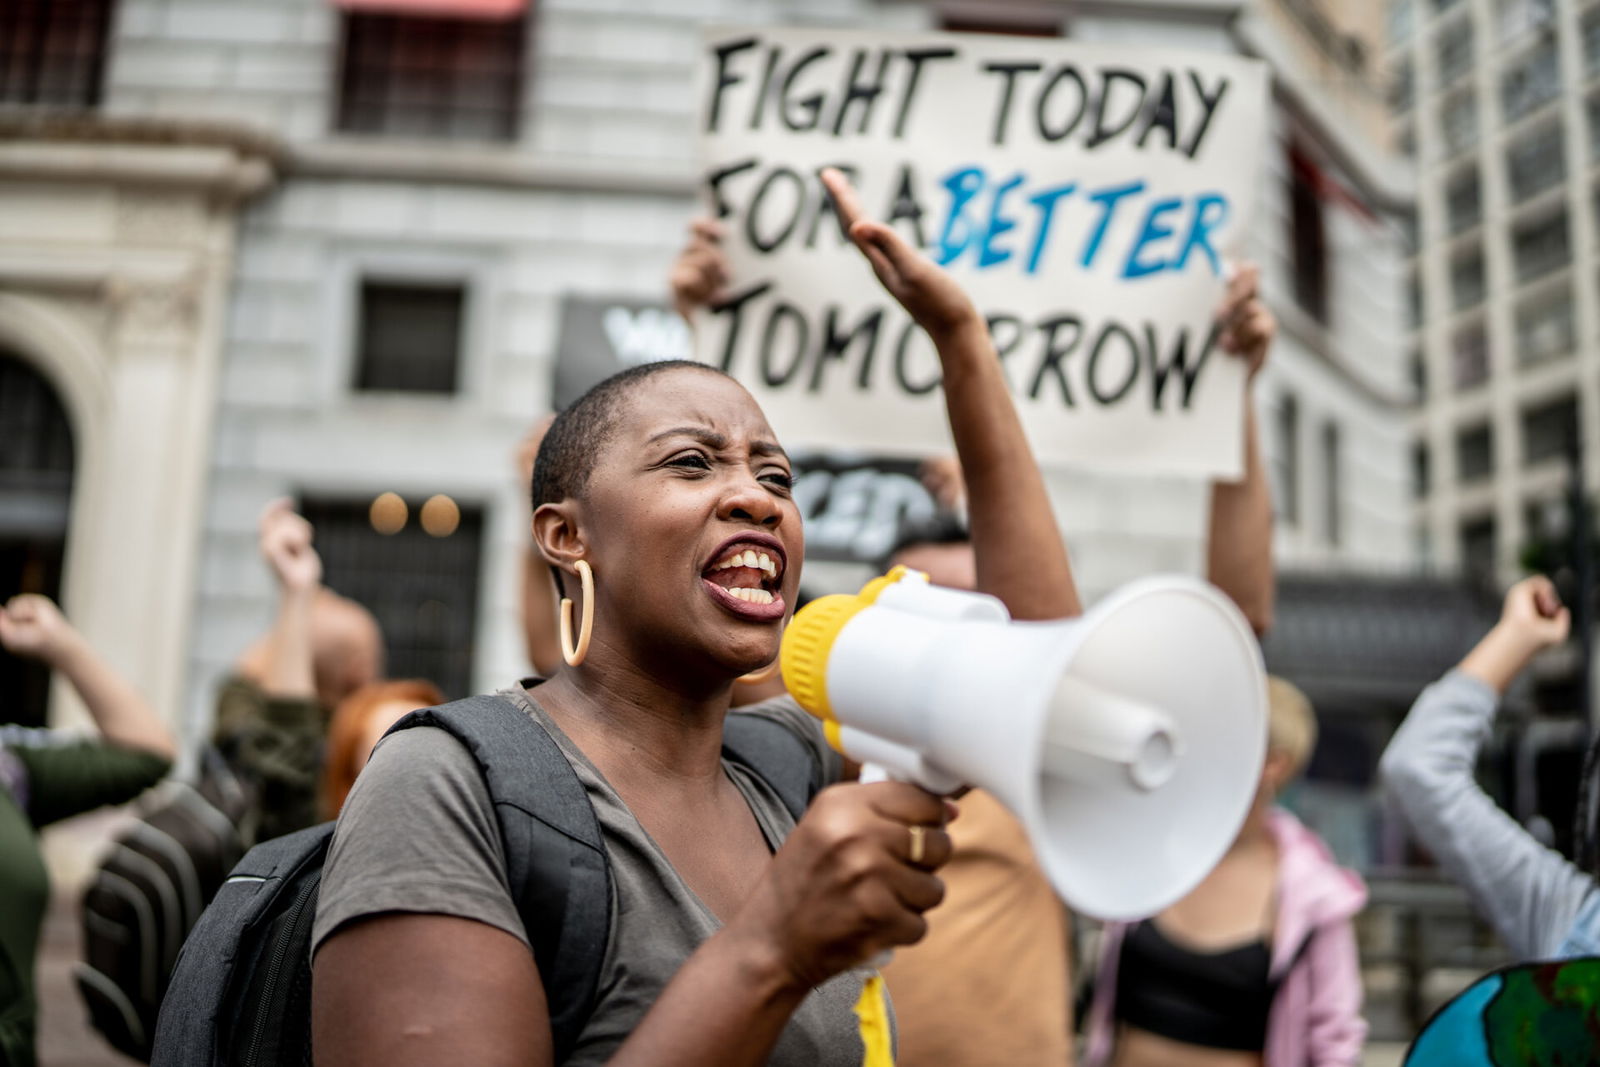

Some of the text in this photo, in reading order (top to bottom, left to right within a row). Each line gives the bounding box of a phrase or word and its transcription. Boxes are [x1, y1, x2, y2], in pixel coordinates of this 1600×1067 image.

[707, 38, 1229, 158] FIGHT TODAY
[886, 162, 926, 248] A
[937, 166, 1229, 281] BETTER
